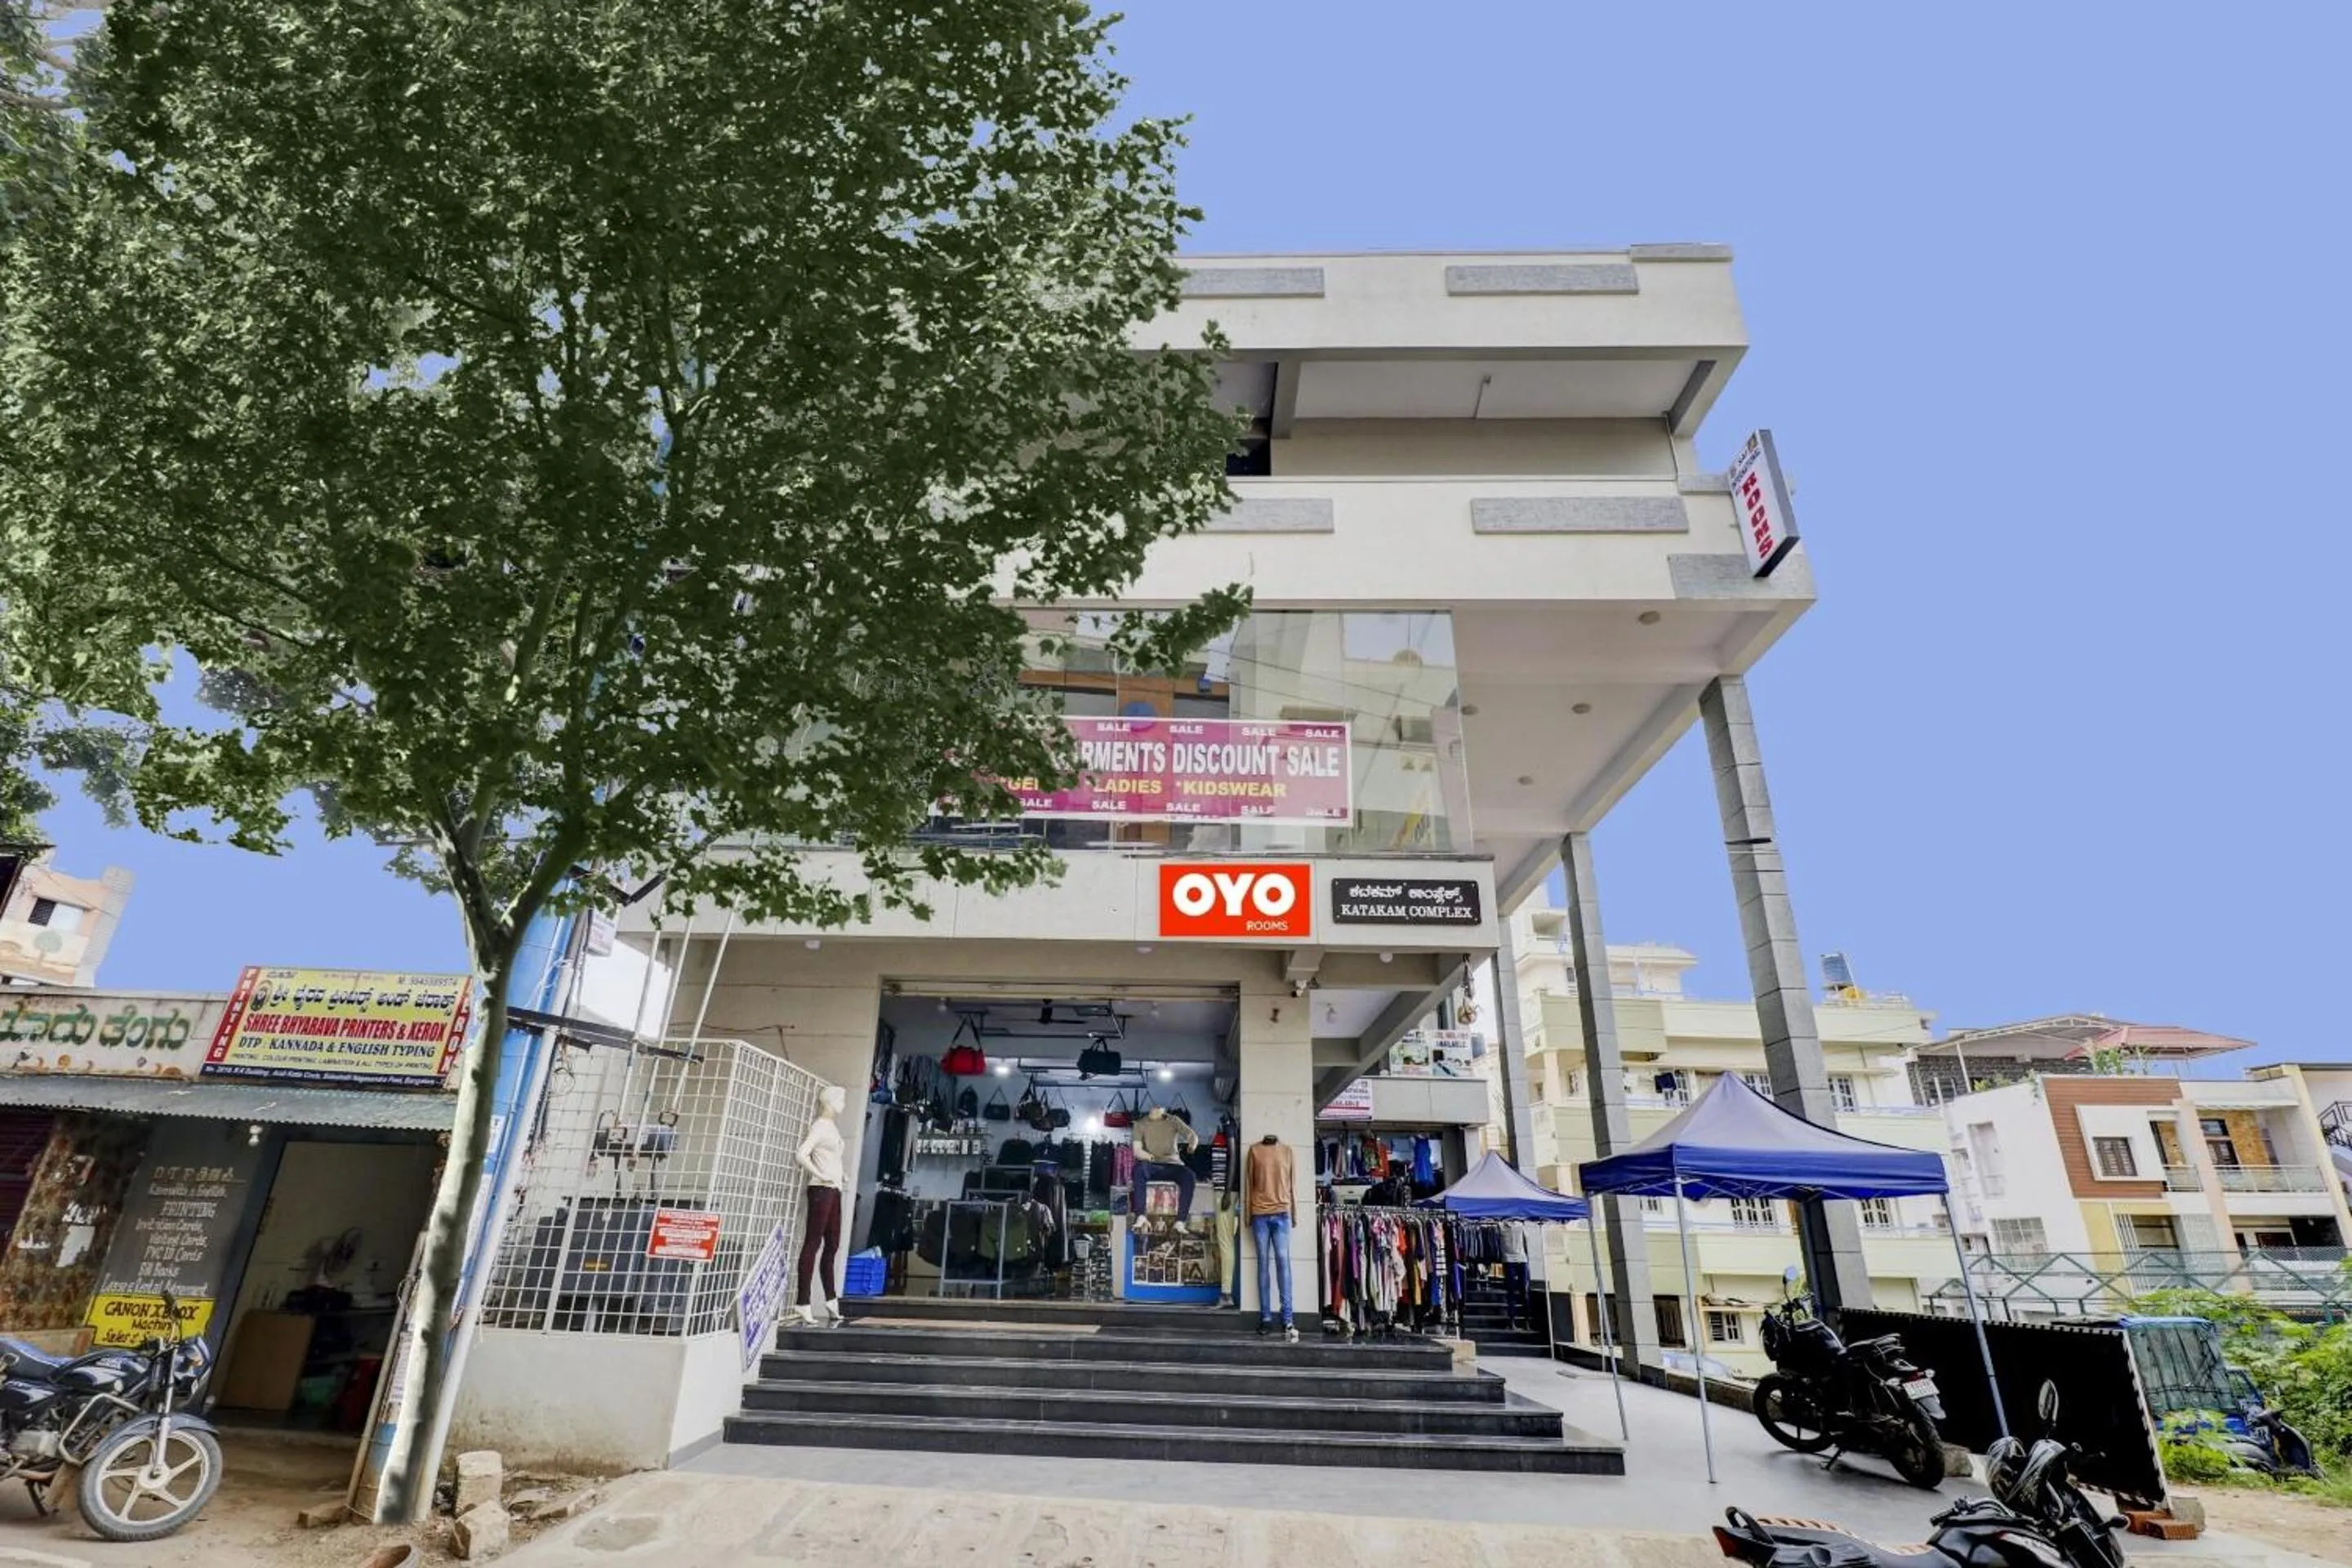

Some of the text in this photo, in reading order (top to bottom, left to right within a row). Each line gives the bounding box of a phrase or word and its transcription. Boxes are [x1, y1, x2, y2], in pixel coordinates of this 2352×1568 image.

[1097, 722, 1340, 738] SALE SALE SALE SALE
[1080, 740, 1340, 777] RMENTS DISCOUNT SALE
[1091, 800, 1126, 810] SALE
[1166, 802, 1201, 813] SALE
[1172, 872, 1296, 917] OYO
[1341, 904, 1472, 918] KATAKAM COMPLEX
[1245, 920, 1289, 932] ROOMS
[243, 1013, 283, 1033] SHREE
[339, 1018, 398, 1040] PRINTERS
[396, 1023, 407, 1040] &
[407, 1022, 448, 1042] XEROX
[238, 1036, 436, 1058] DTP KANNADA & ENGLISH TYPING
[105, 1300, 149, 1317] CANON
[131, 1318, 172, 1331] Machin
